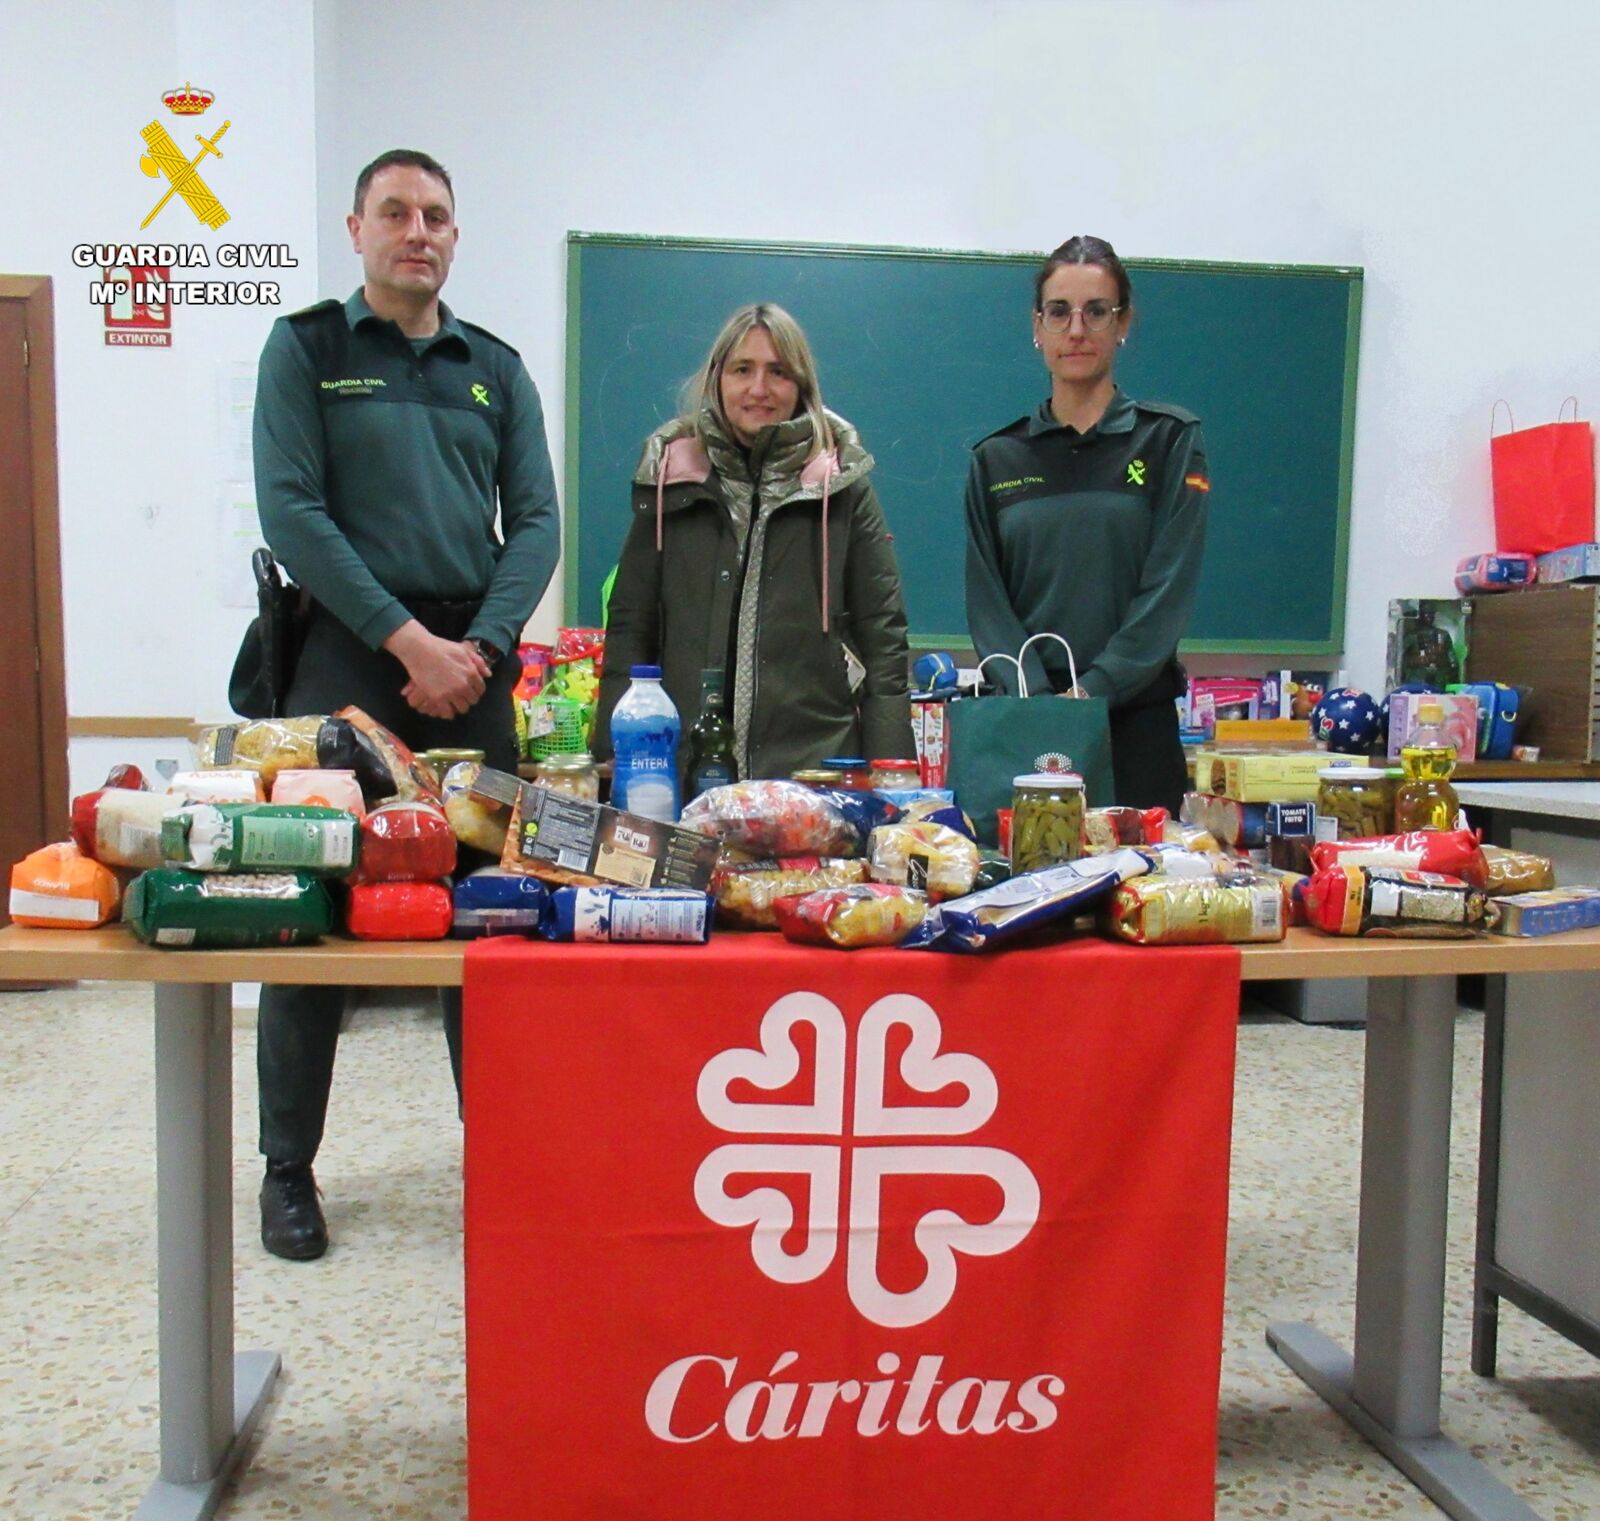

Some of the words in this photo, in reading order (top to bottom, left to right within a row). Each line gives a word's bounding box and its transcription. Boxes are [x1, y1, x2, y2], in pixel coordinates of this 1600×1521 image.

[109, 332, 167, 345] EXTINTOR
[321, 379, 363, 389] GUARDIA
[364, 378, 387, 386] CIVIL
[631, 758, 669, 770] ENTERA
[1280, 808, 1307, 817] TOMATE
[1284, 814, 1303, 823] FRITO
[644, 1350, 1066, 1444] Cáritas
